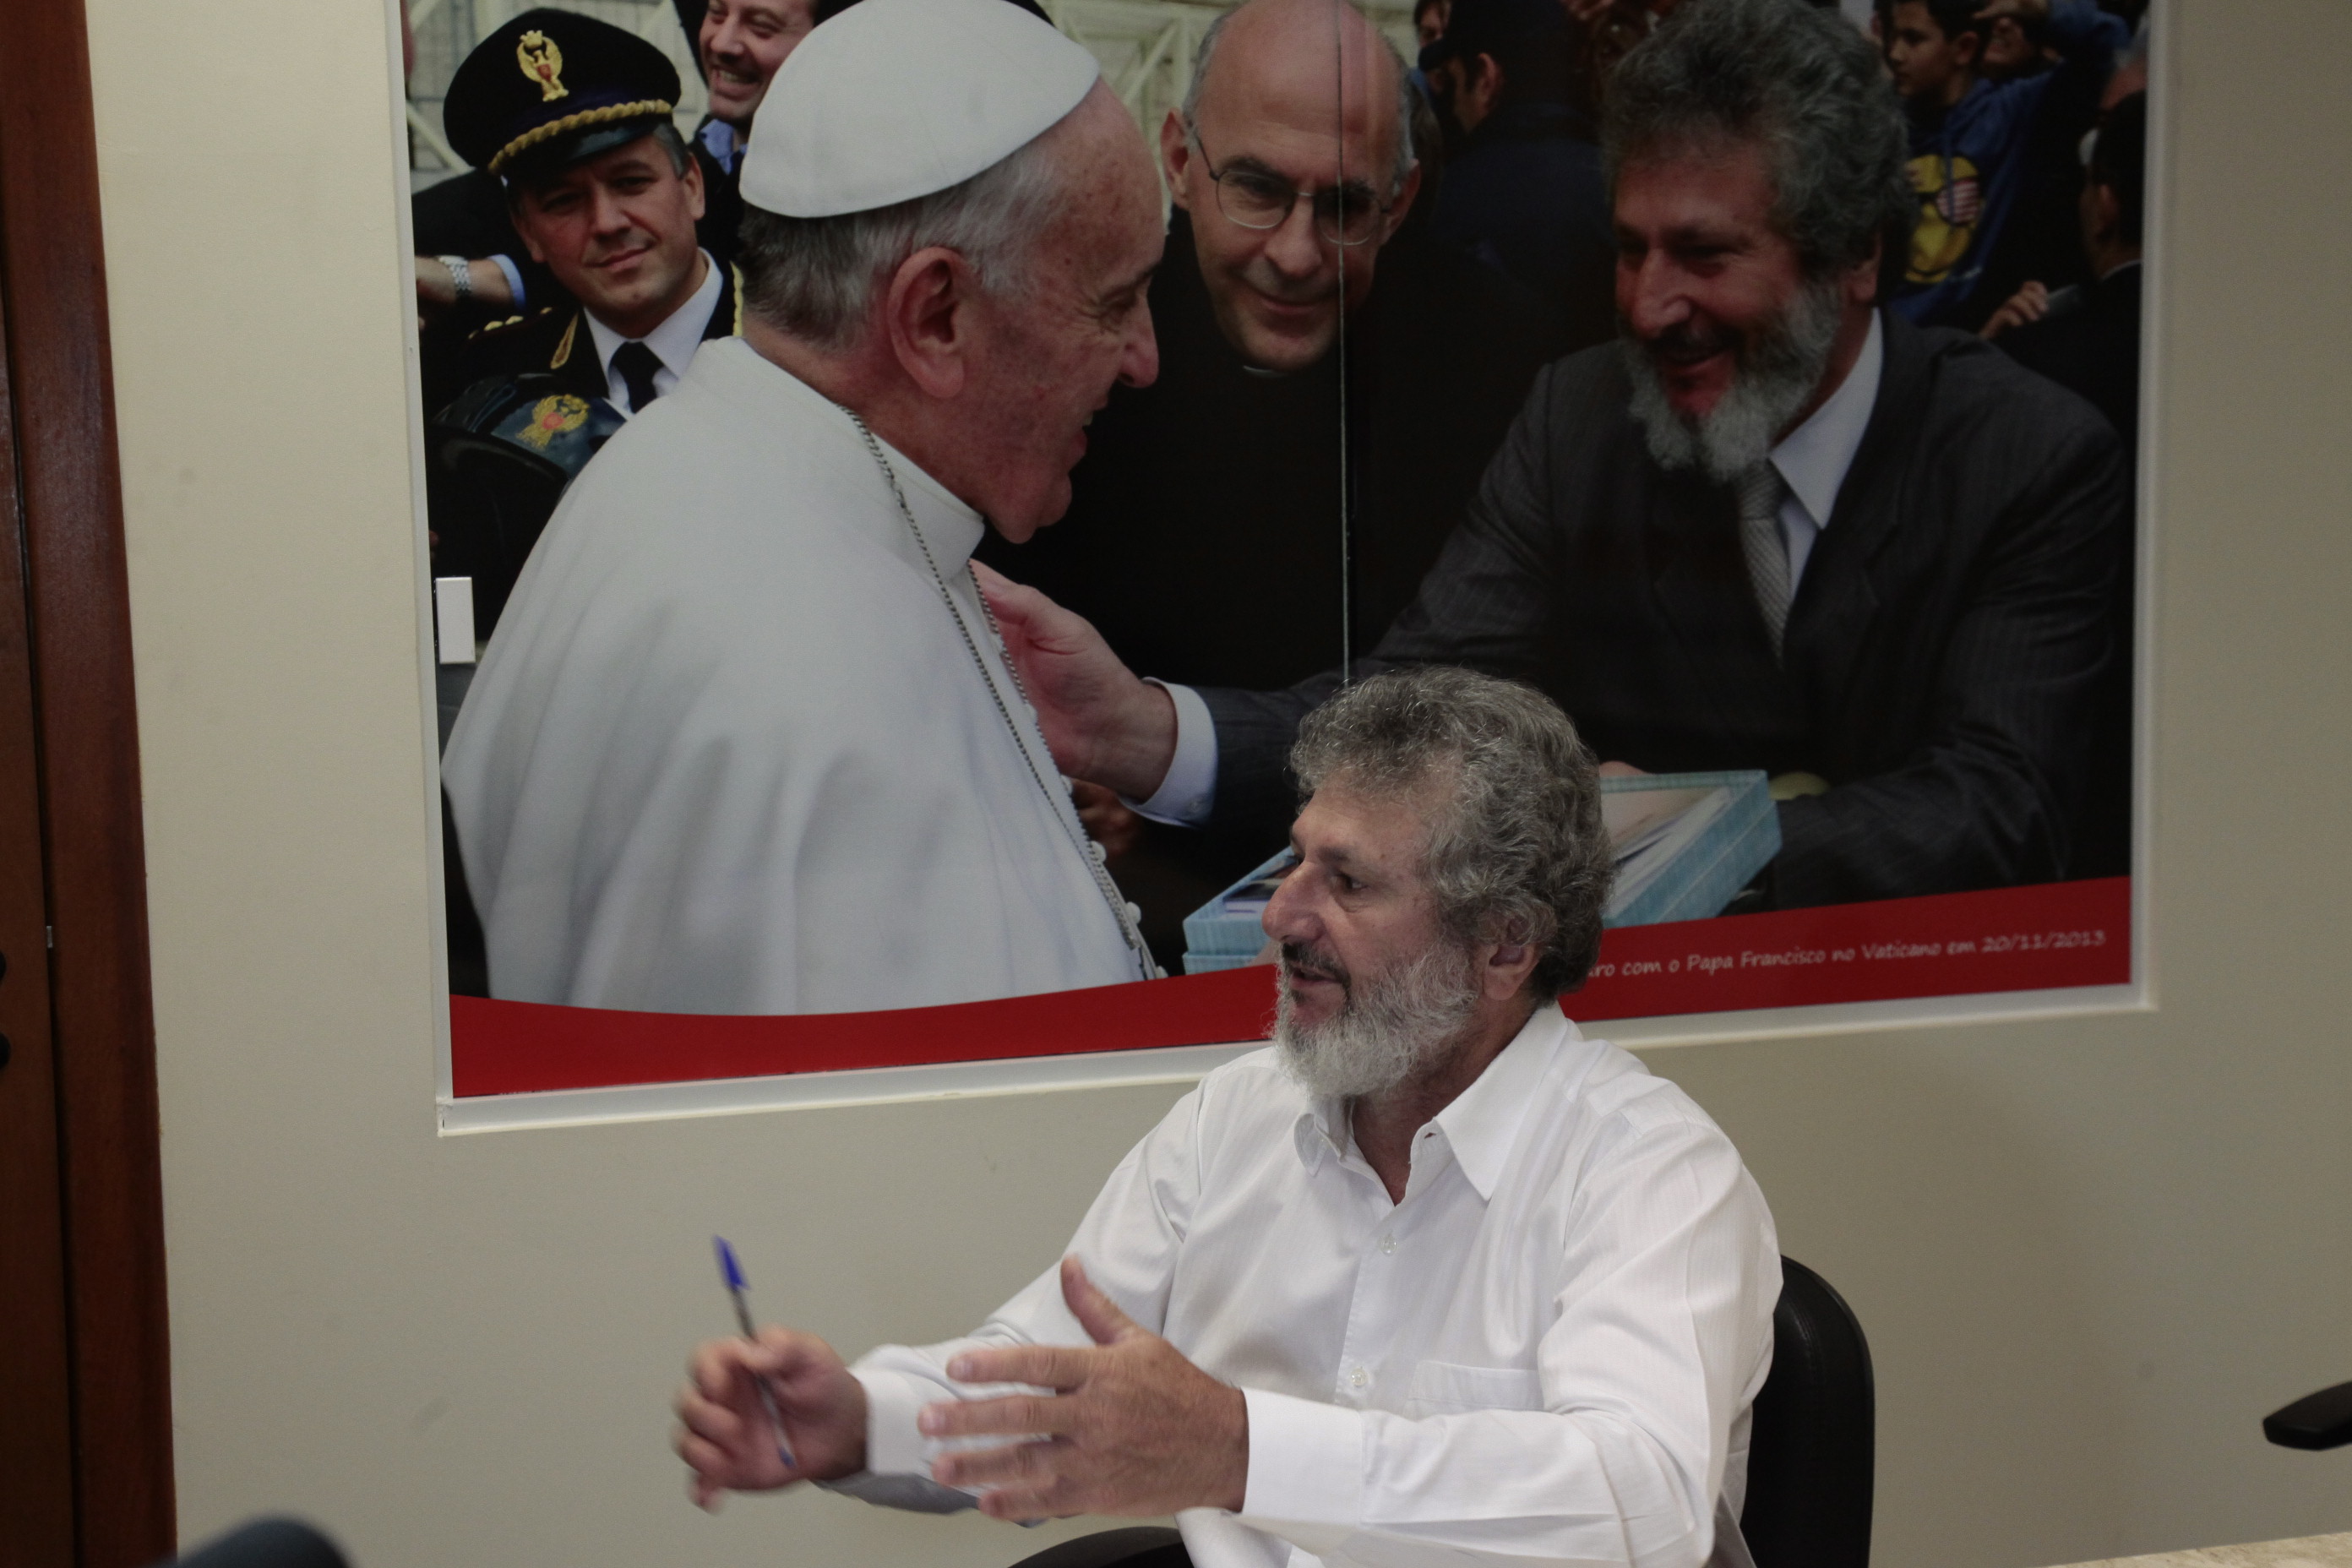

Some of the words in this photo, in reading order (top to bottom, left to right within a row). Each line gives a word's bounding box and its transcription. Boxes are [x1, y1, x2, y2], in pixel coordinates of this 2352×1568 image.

[1621, 961, 1663, 976] com
[1668, 958, 1681, 973] o
[1686, 953, 1734, 976] Papa
[1740, 946, 1827, 968] Francisco
[1831, 948, 1856, 961] no
[1861, 939, 1941, 960] Vaticano
[1946, 940, 1977, 956] em
[1981, 929, 2107, 952] 20/11/2013
